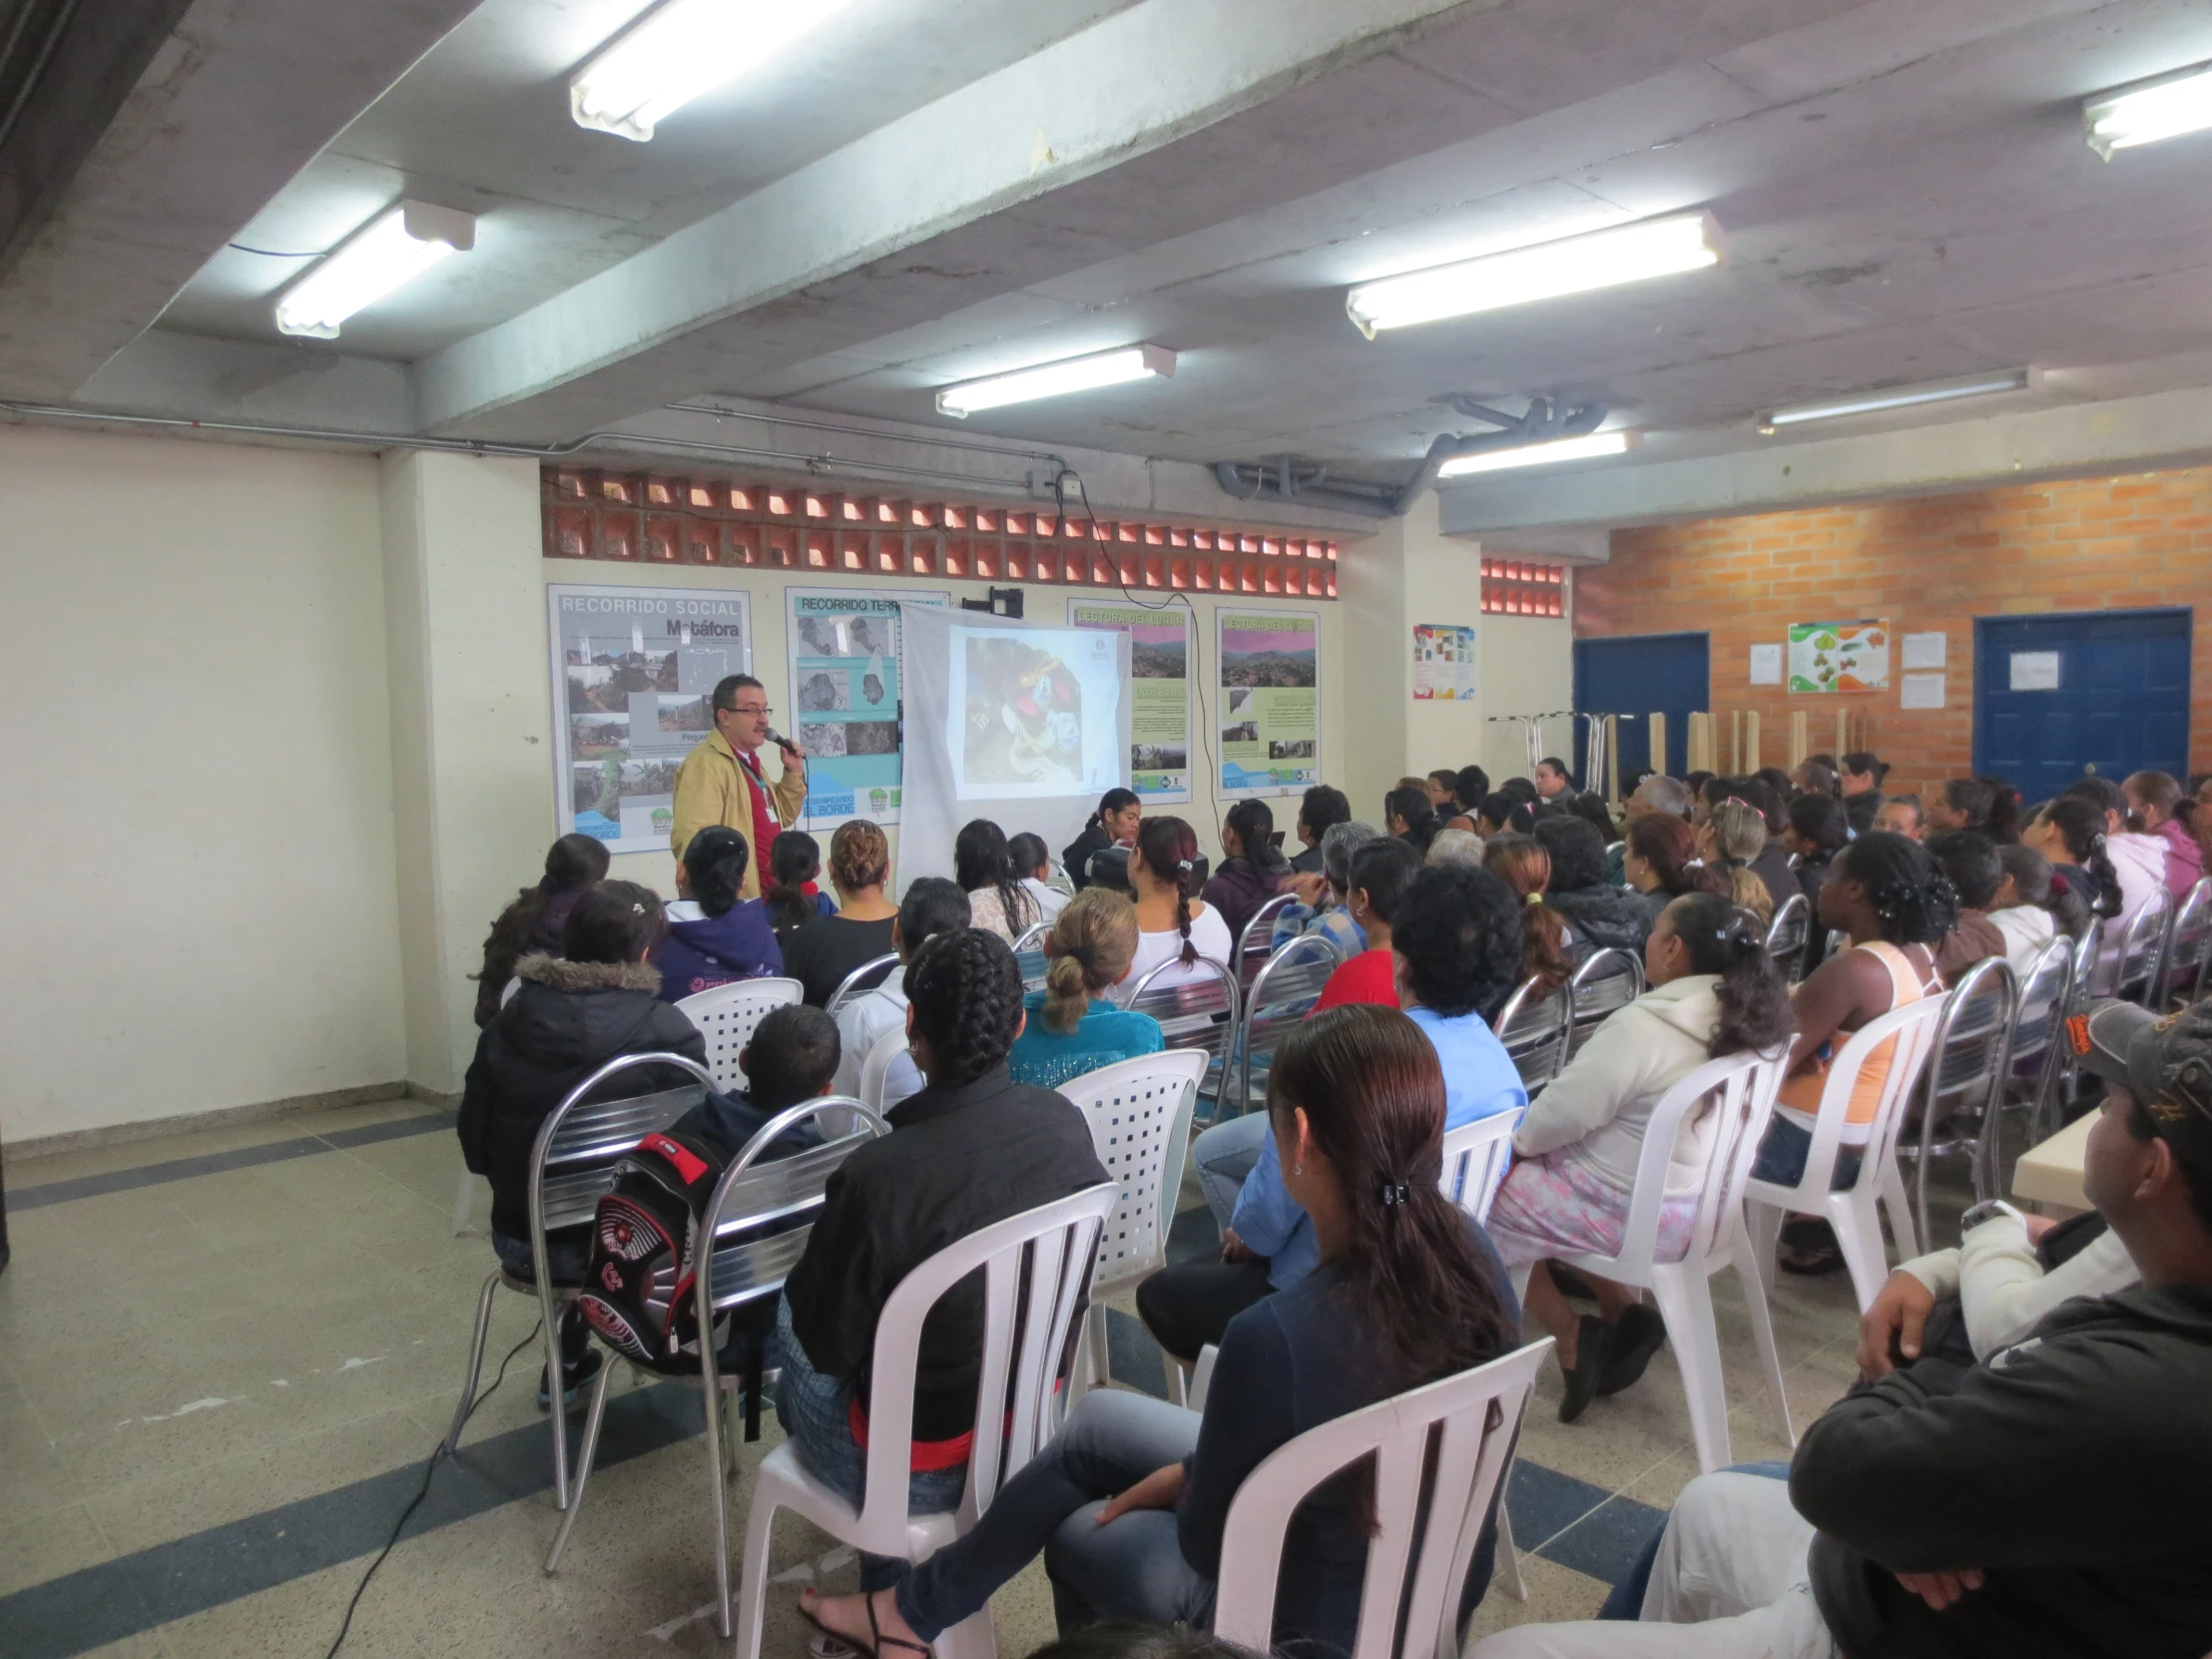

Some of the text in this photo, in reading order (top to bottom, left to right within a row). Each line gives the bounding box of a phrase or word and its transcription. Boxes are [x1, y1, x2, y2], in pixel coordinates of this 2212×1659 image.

[563, 598, 739, 616] RECORRIDO SOCIAL
[803, 598, 900, 611] RECORRIDO TERR
[1078, 610, 1184, 627] LECTURA DEL LUGAR
[1225, 619, 1264, 631] LECTURA
[1267, 620, 1283, 631] DEL
[819, 803, 854, 816] BORDE
